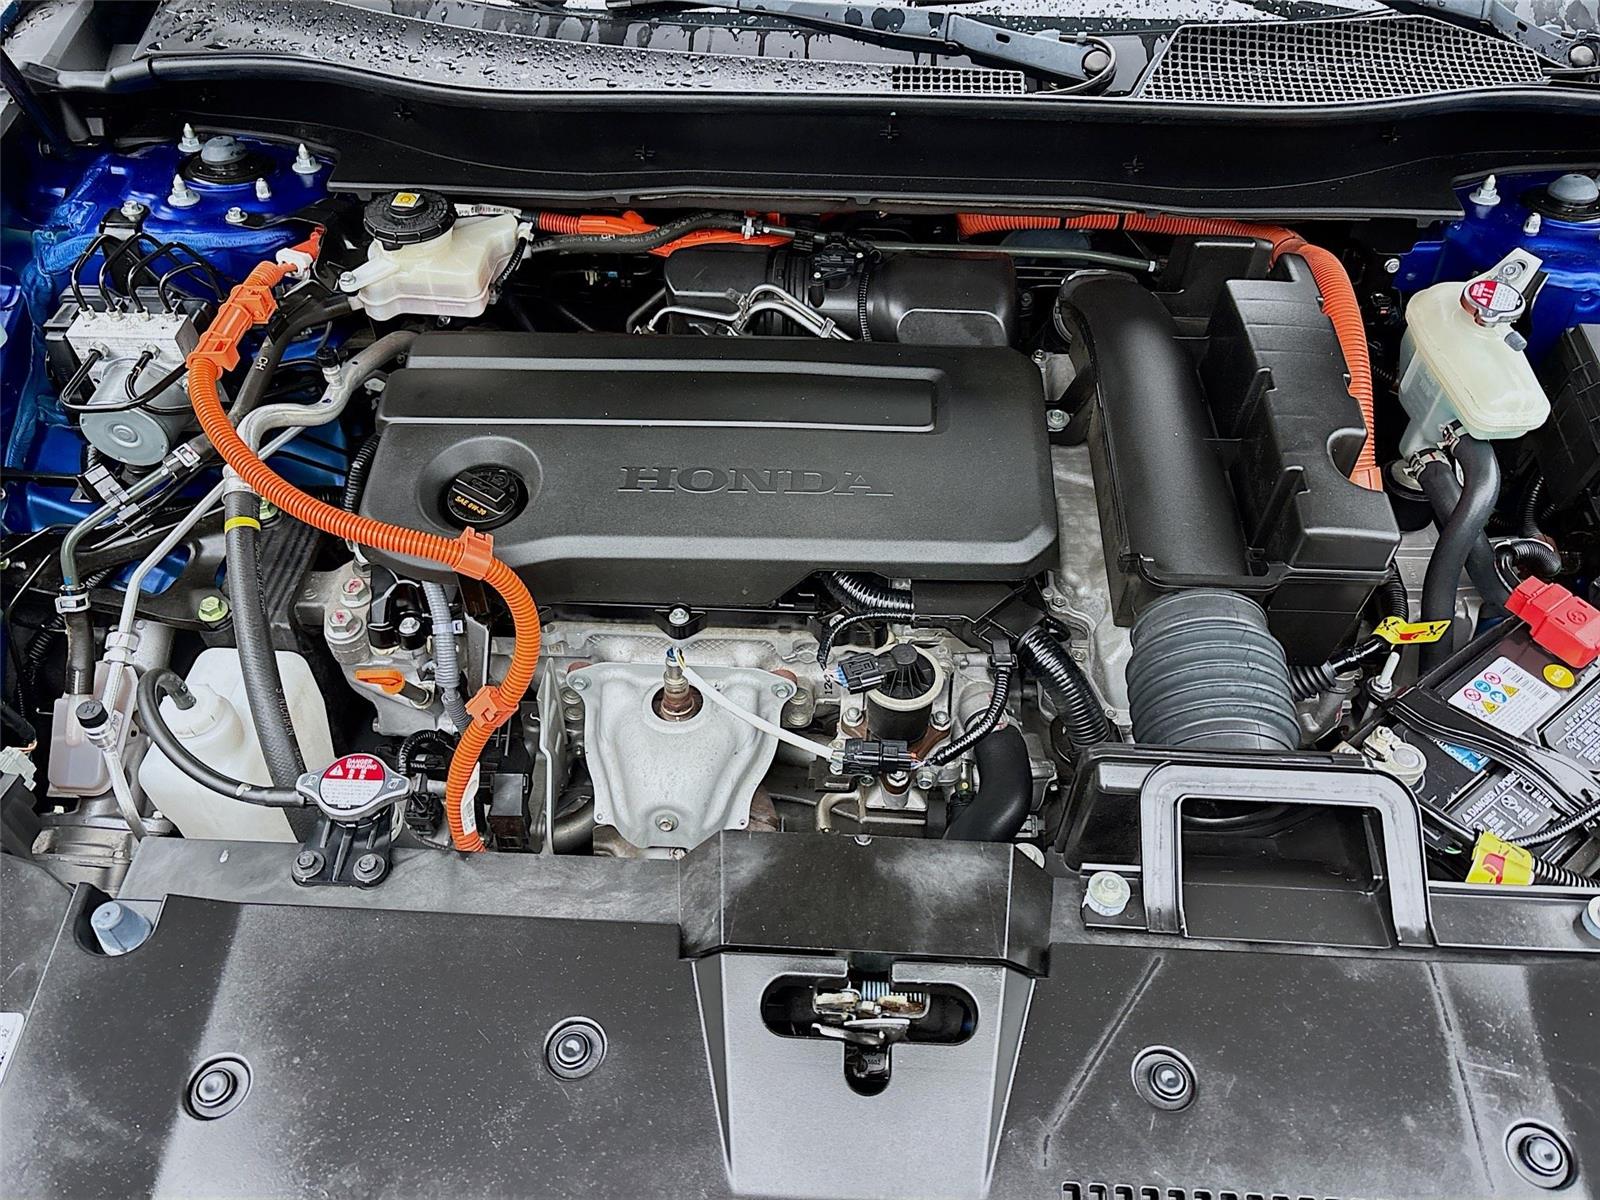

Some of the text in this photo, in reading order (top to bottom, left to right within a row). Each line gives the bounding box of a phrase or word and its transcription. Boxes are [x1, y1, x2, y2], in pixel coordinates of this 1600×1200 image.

[255, 356, 269, 371] CH
[617, 466, 894, 497] HONDA
[455, 495, 469, 506] SAE
[345, 762, 378, 771] WARNING
[346, 757, 374, 766] DANGER
[1466, 790, 1498, 817] DANGER
